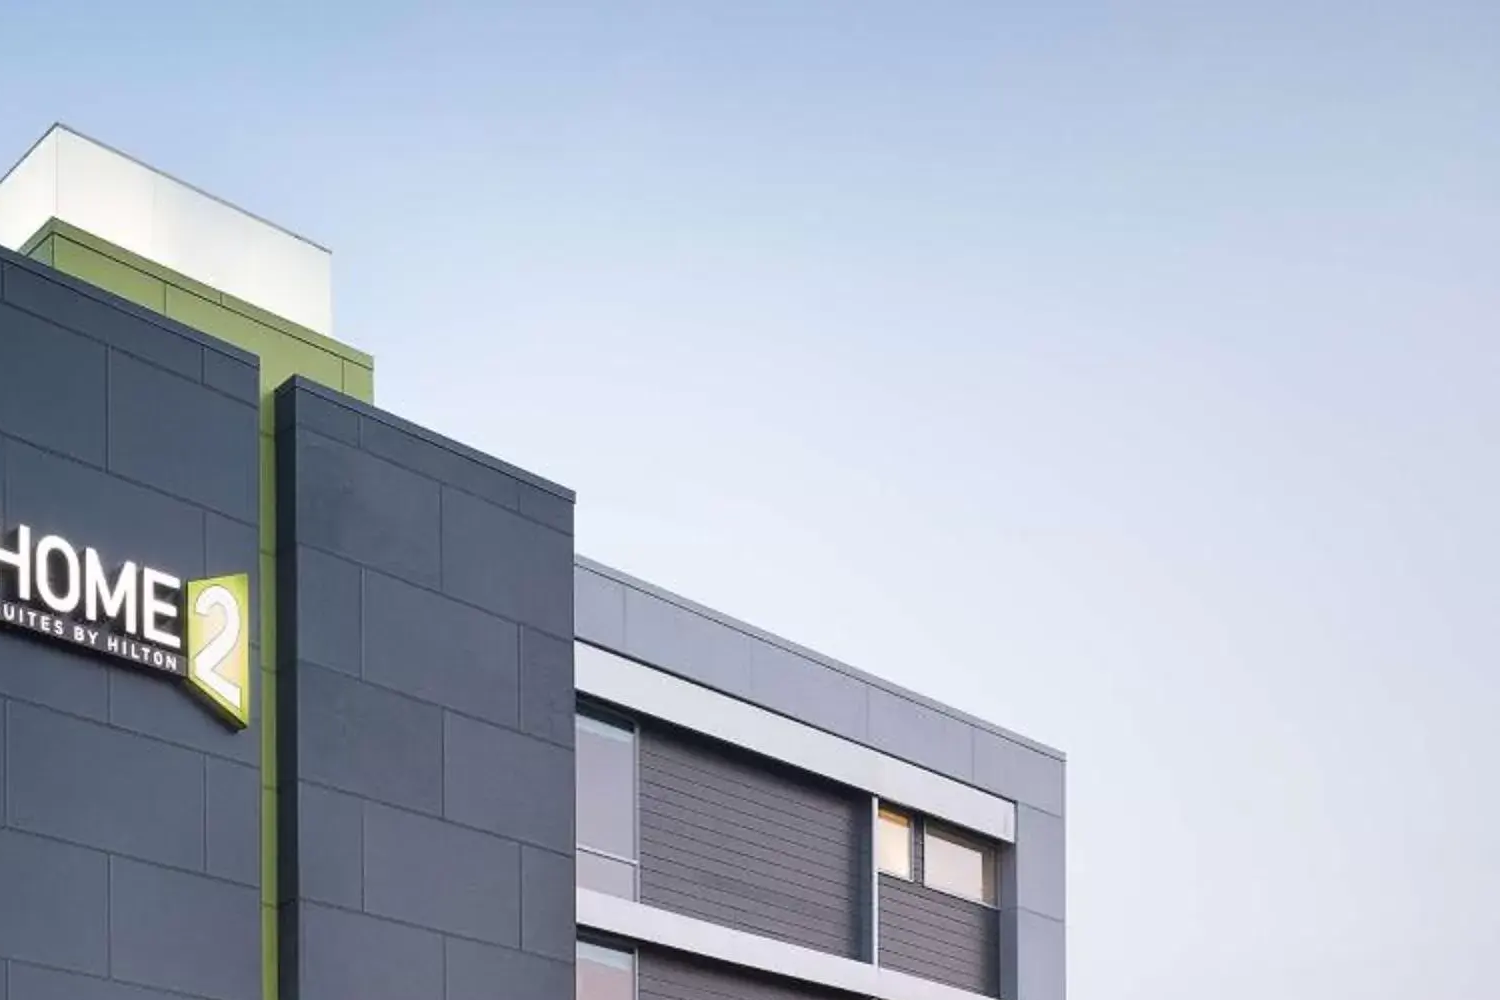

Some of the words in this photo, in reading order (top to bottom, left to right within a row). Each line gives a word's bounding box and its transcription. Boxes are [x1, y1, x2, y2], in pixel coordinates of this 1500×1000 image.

[73, 626, 100, 645] BY
[107, 635, 178, 671] HILTON
[194, 584, 242, 709] 2
